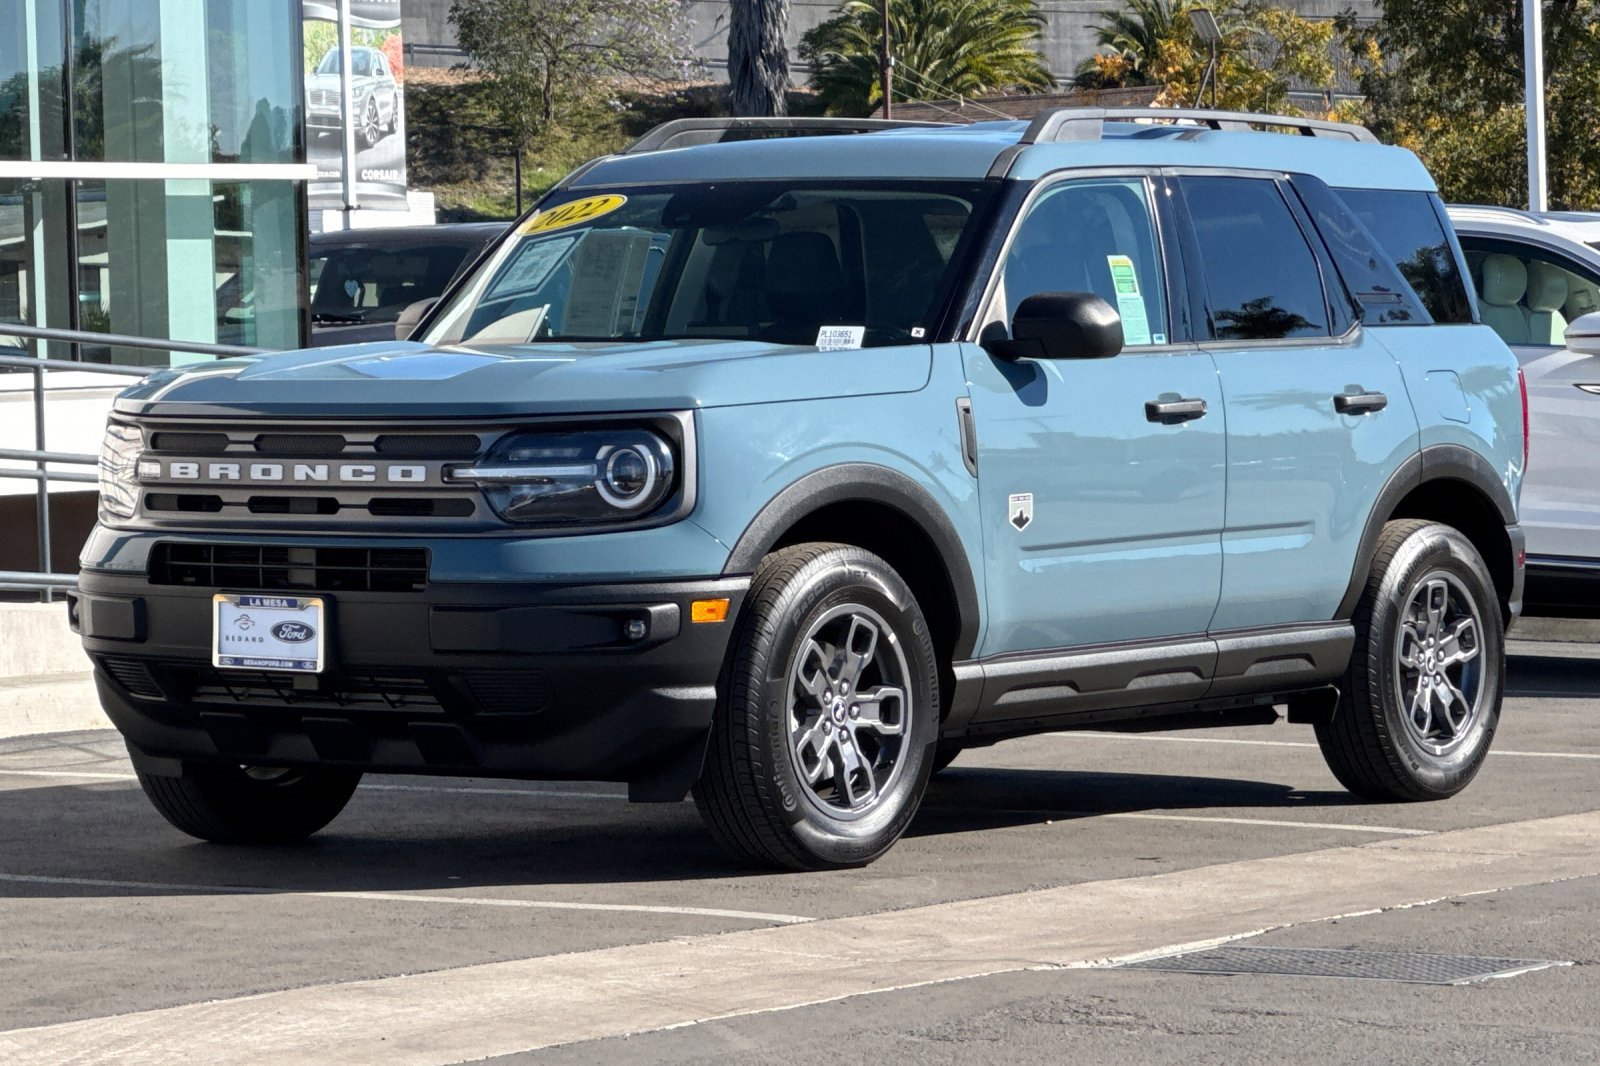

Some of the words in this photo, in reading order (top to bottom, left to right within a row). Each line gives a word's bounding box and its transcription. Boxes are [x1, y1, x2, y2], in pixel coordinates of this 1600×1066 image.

[361, 169, 399, 181] CORSAIR
[528, 198, 611, 231] 2022
[170, 462, 426, 482] BRONCO
[249, 598, 261, 606] LA
[263, 598, 288, 608] MESA
[278, 623, 307, 640] Ford
[225, 635, 264, 643] SEDANO
